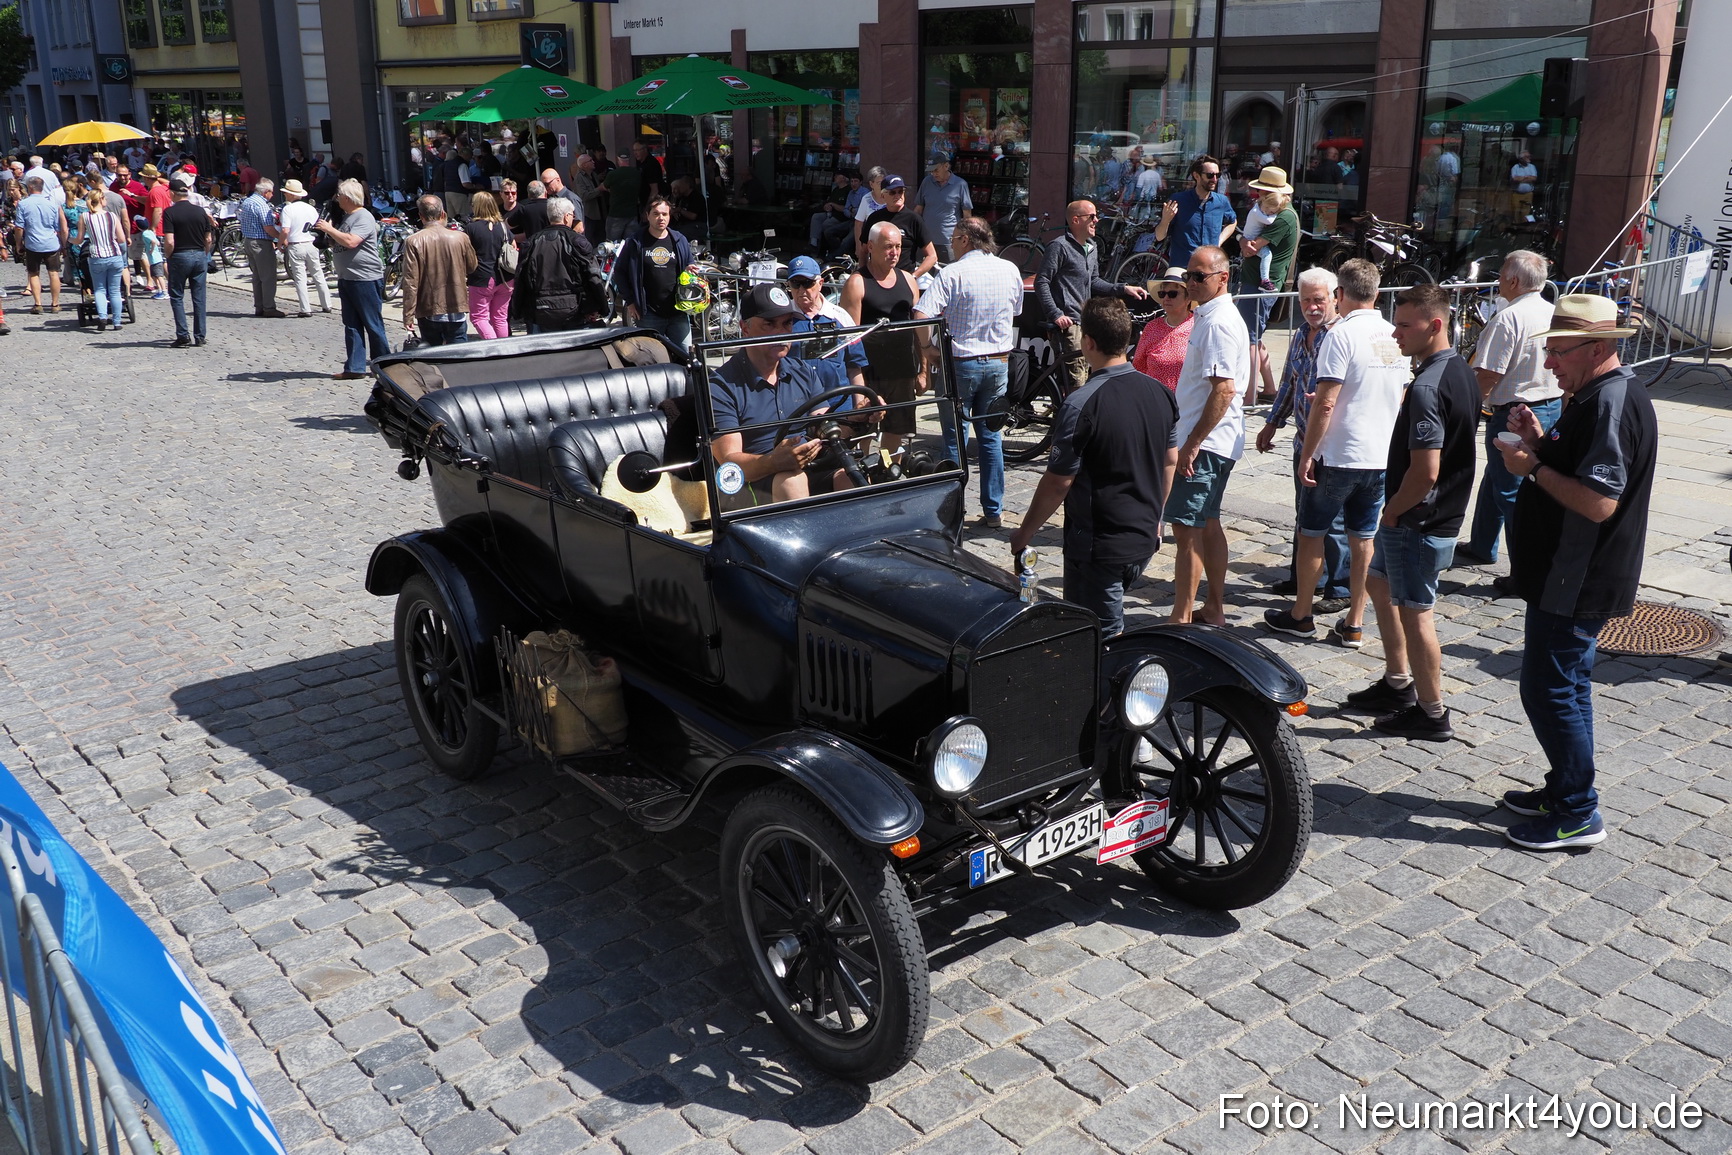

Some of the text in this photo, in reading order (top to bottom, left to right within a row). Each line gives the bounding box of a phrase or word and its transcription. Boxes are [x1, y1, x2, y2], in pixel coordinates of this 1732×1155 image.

[623, 17, 664, 29] Unterer Markt 15
[660, 251, 676, 260] Rock
[1148, 813, 1162, 829] 19
[974, 871, 981, 881] D
[1037, 808, 1102, 860] 1923H
